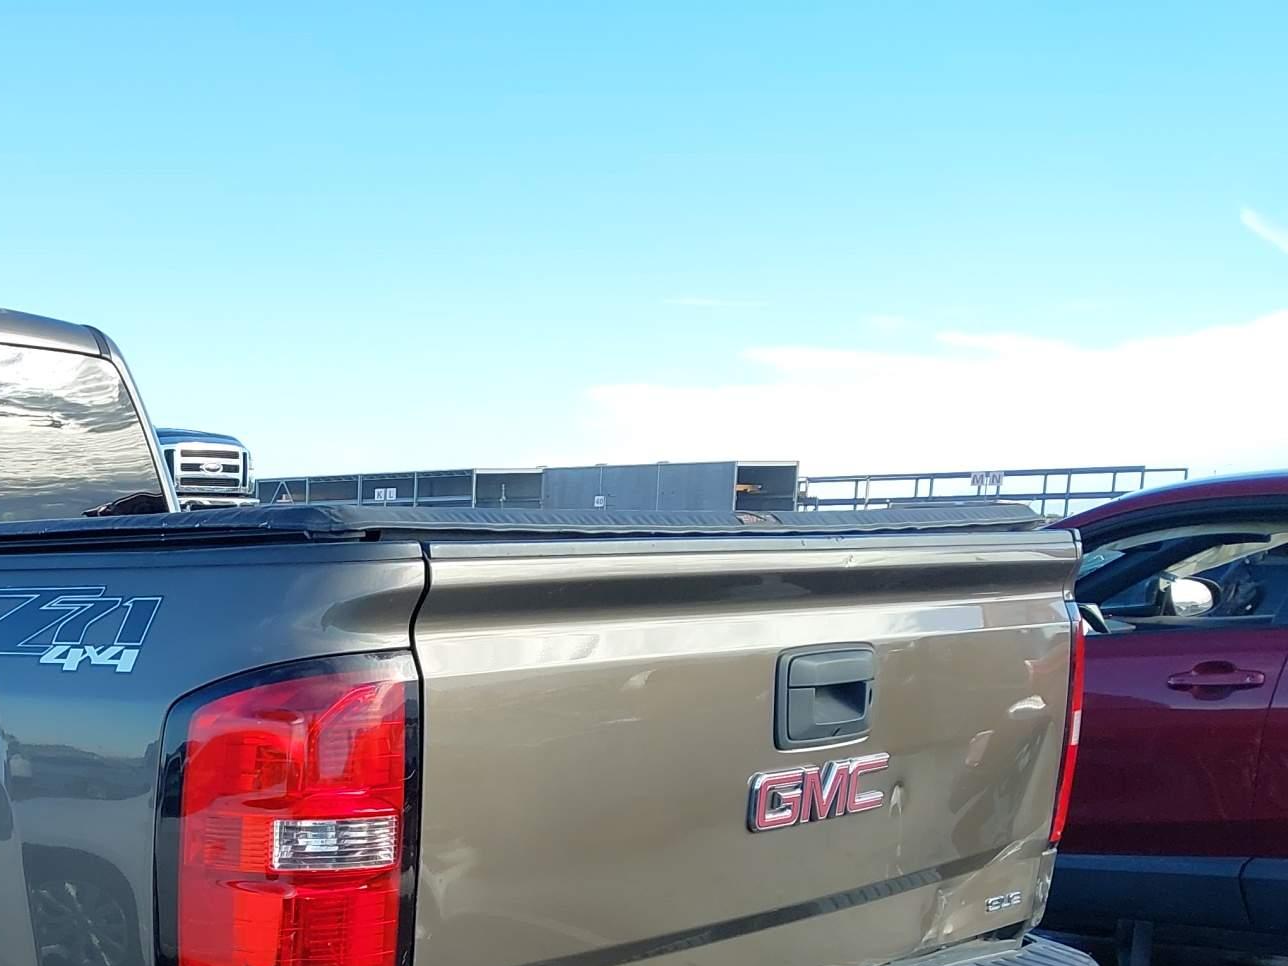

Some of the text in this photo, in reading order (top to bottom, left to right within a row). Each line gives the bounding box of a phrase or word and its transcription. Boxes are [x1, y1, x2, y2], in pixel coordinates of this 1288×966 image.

[972, 474, 985, 485] M
[991, 473, 1002, 484] N
[747, 752, 890, 833] GMC
[984, 891, 1022, 912] SLE
